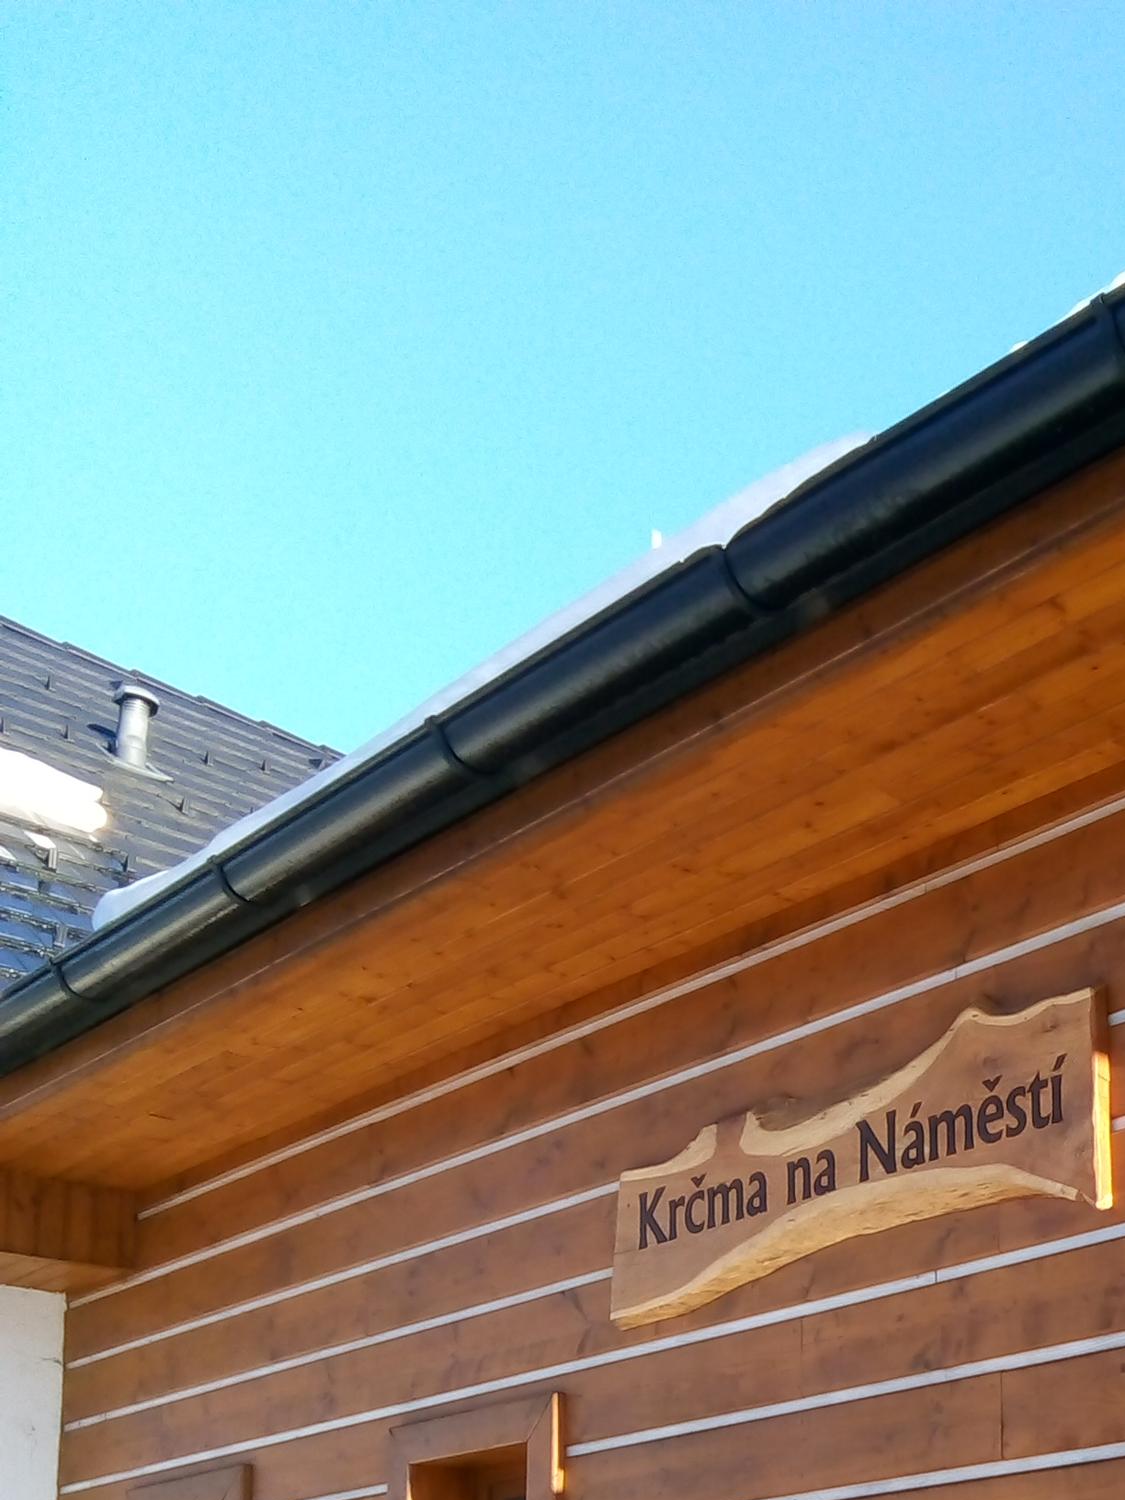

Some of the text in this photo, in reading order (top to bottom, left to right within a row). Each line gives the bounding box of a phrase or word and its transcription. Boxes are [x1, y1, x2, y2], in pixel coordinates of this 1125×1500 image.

[638, 1053, 1068, 1250] Krčma na Náměstí
